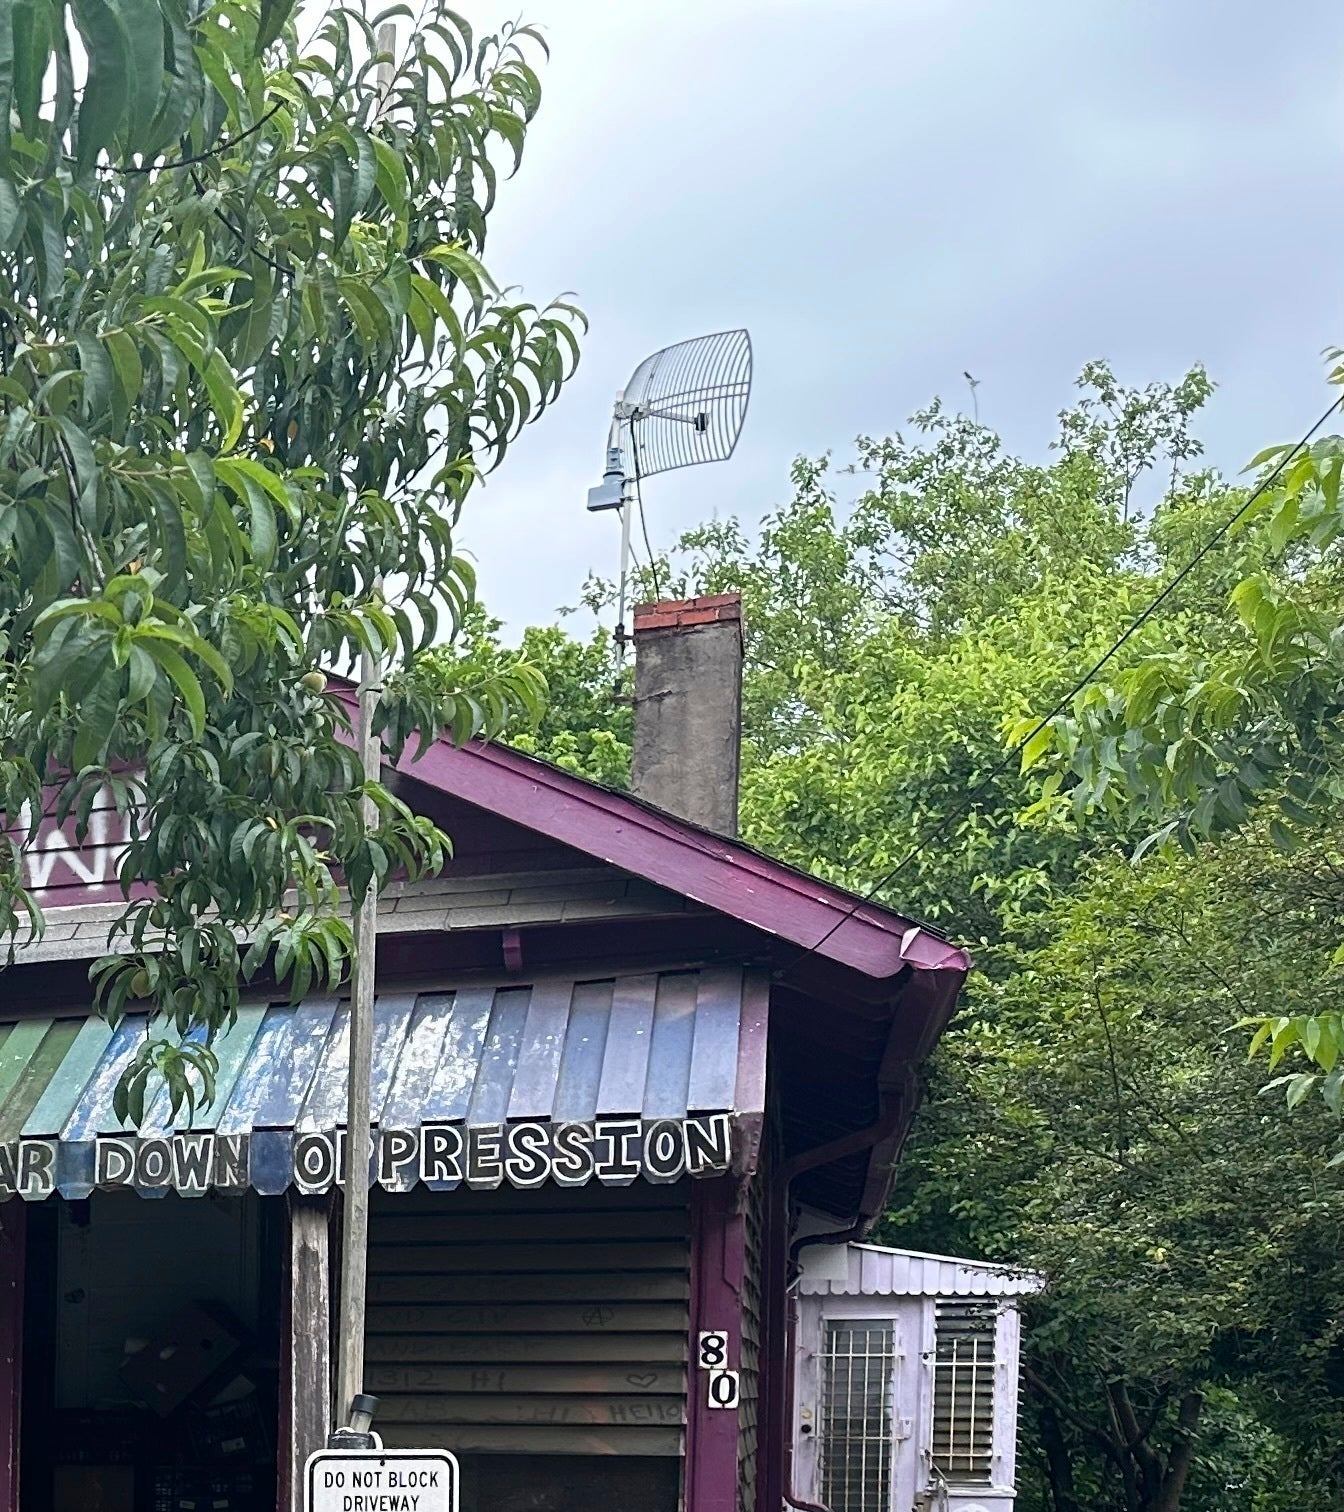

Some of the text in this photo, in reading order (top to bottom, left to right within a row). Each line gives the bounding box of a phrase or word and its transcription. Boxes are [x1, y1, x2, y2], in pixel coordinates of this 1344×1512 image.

[95, 1133, 250, 1190] DOWN
[700, 1334, 737, 1405] 80
[324, 1471, 439, 1488] DO NOT BLOCK
[343, 1495, 420, 1512] DRIVEWAY
